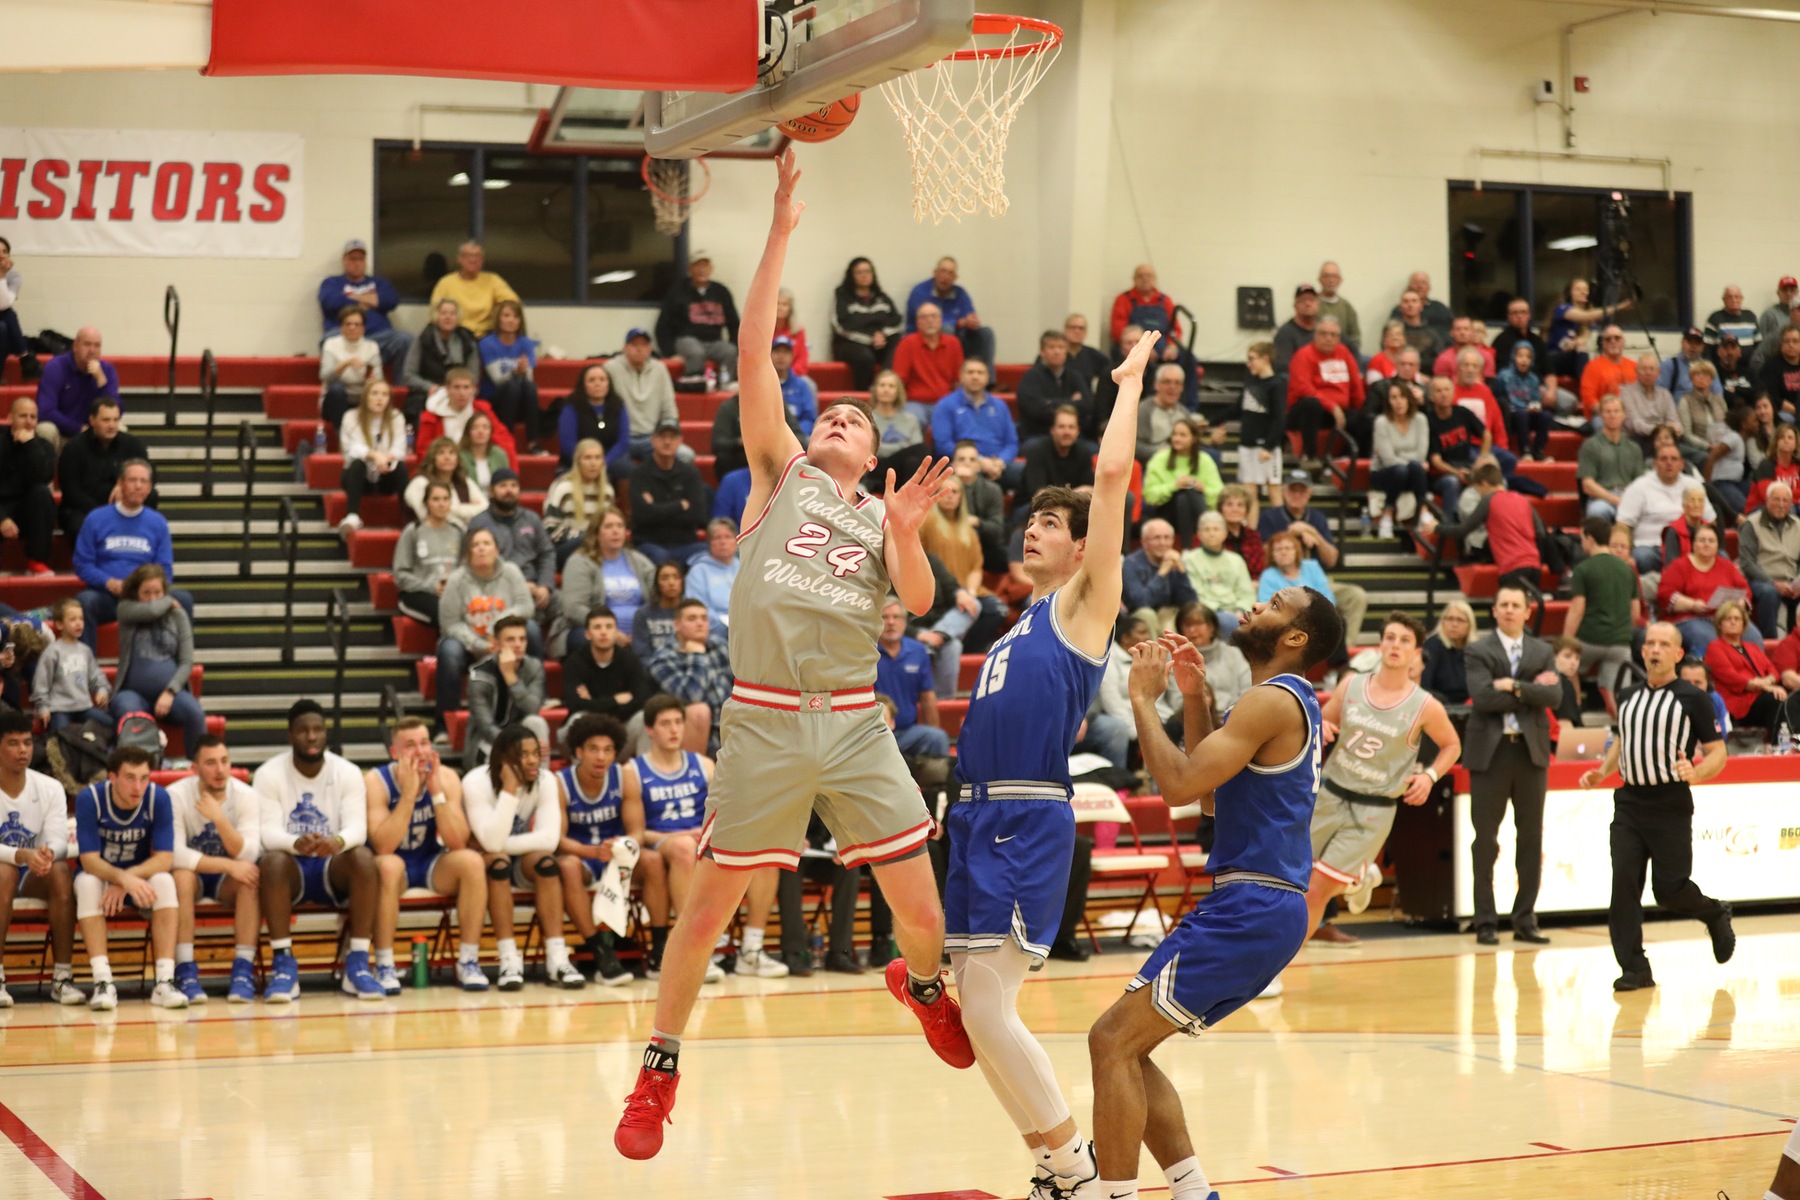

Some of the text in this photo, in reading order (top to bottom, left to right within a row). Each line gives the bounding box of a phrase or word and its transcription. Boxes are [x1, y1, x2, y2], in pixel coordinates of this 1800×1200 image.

[799, 486, 883, 548] Indiana
[785, 521, 868, 578] 24
[764, 558, 871, 611] Wesleyan
[976, 645, 1012, 700] 15
[1344, 728, 1384, 759] 13
[569, 806, 618, 824] BETHEL
[650, 782, 699, 802] BETHEL
